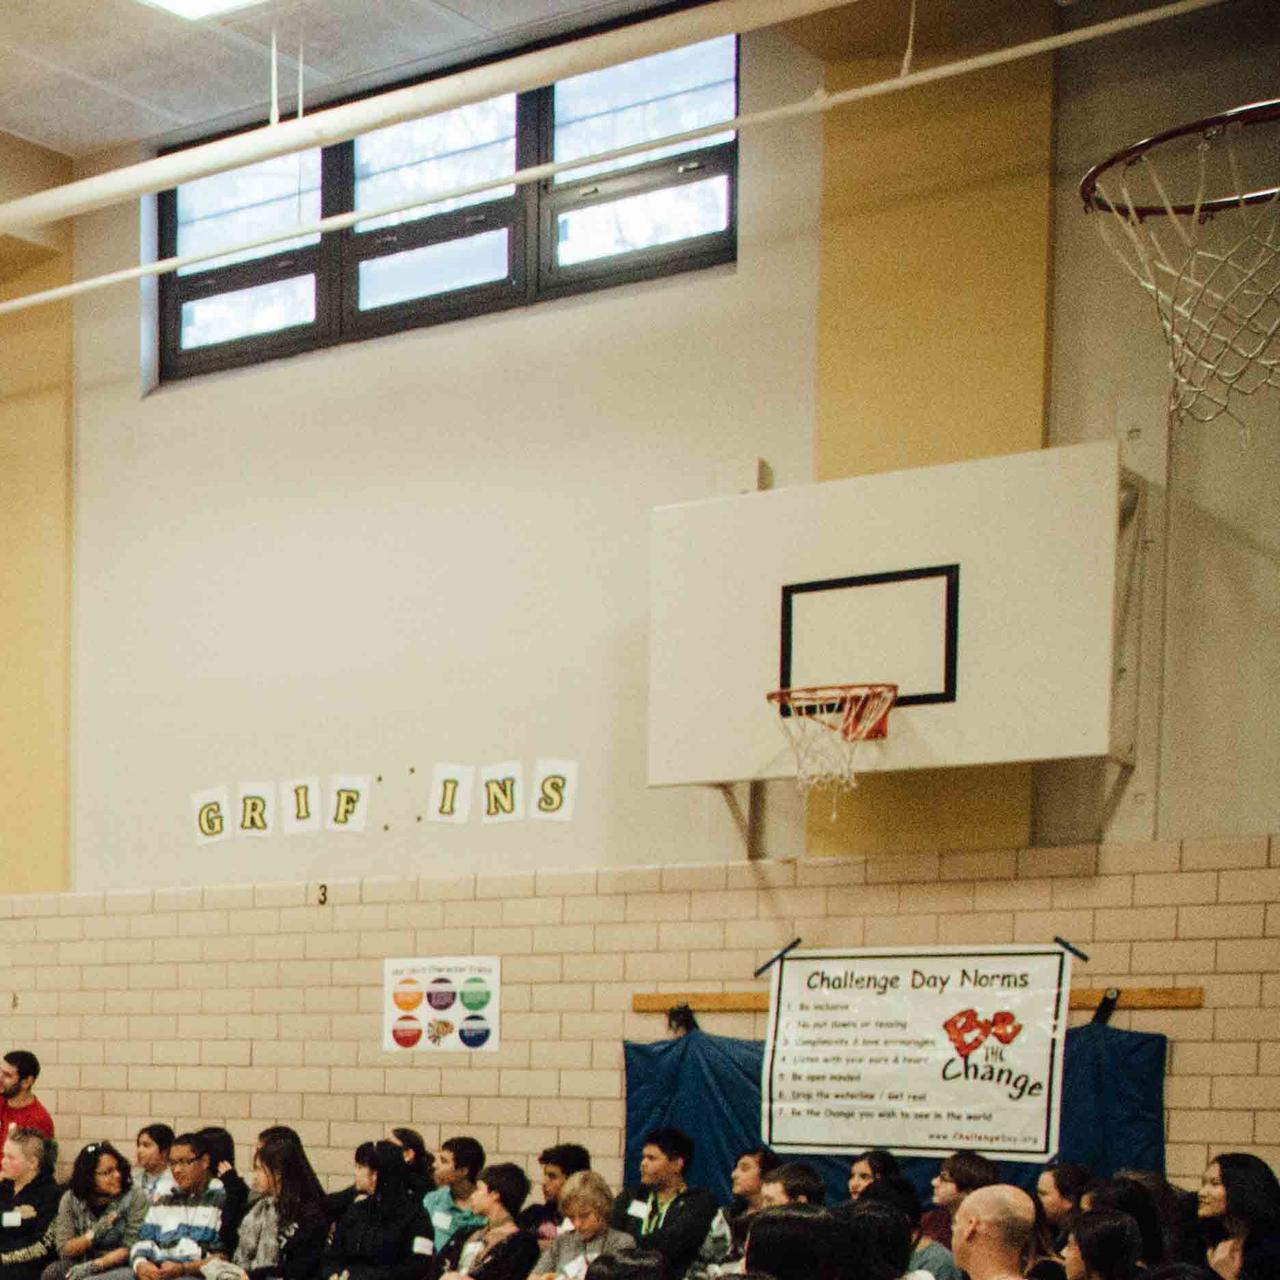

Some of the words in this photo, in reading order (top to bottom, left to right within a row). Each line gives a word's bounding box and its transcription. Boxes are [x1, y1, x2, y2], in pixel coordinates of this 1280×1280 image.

[198, 786, 360, 836] GRIF
[439, 776, 566, 816] INS
[317, 884, 328, 905] 3
[806, 970, 901, 996] Challenge
[911, 969, 951, 995] Day
[960, 968, 1029, 988] Norms
[943, 1008, 1023, 1058] Be
[942, 1054, 1043, 1101] Change
[824, 1108, 856, 1119] Change
[859, 1110, 875, 1120] you
[900, 1110, 910, 1118] to
[947, 1110, 961, 1120] the
[966, 1111, 993, 1121] world
